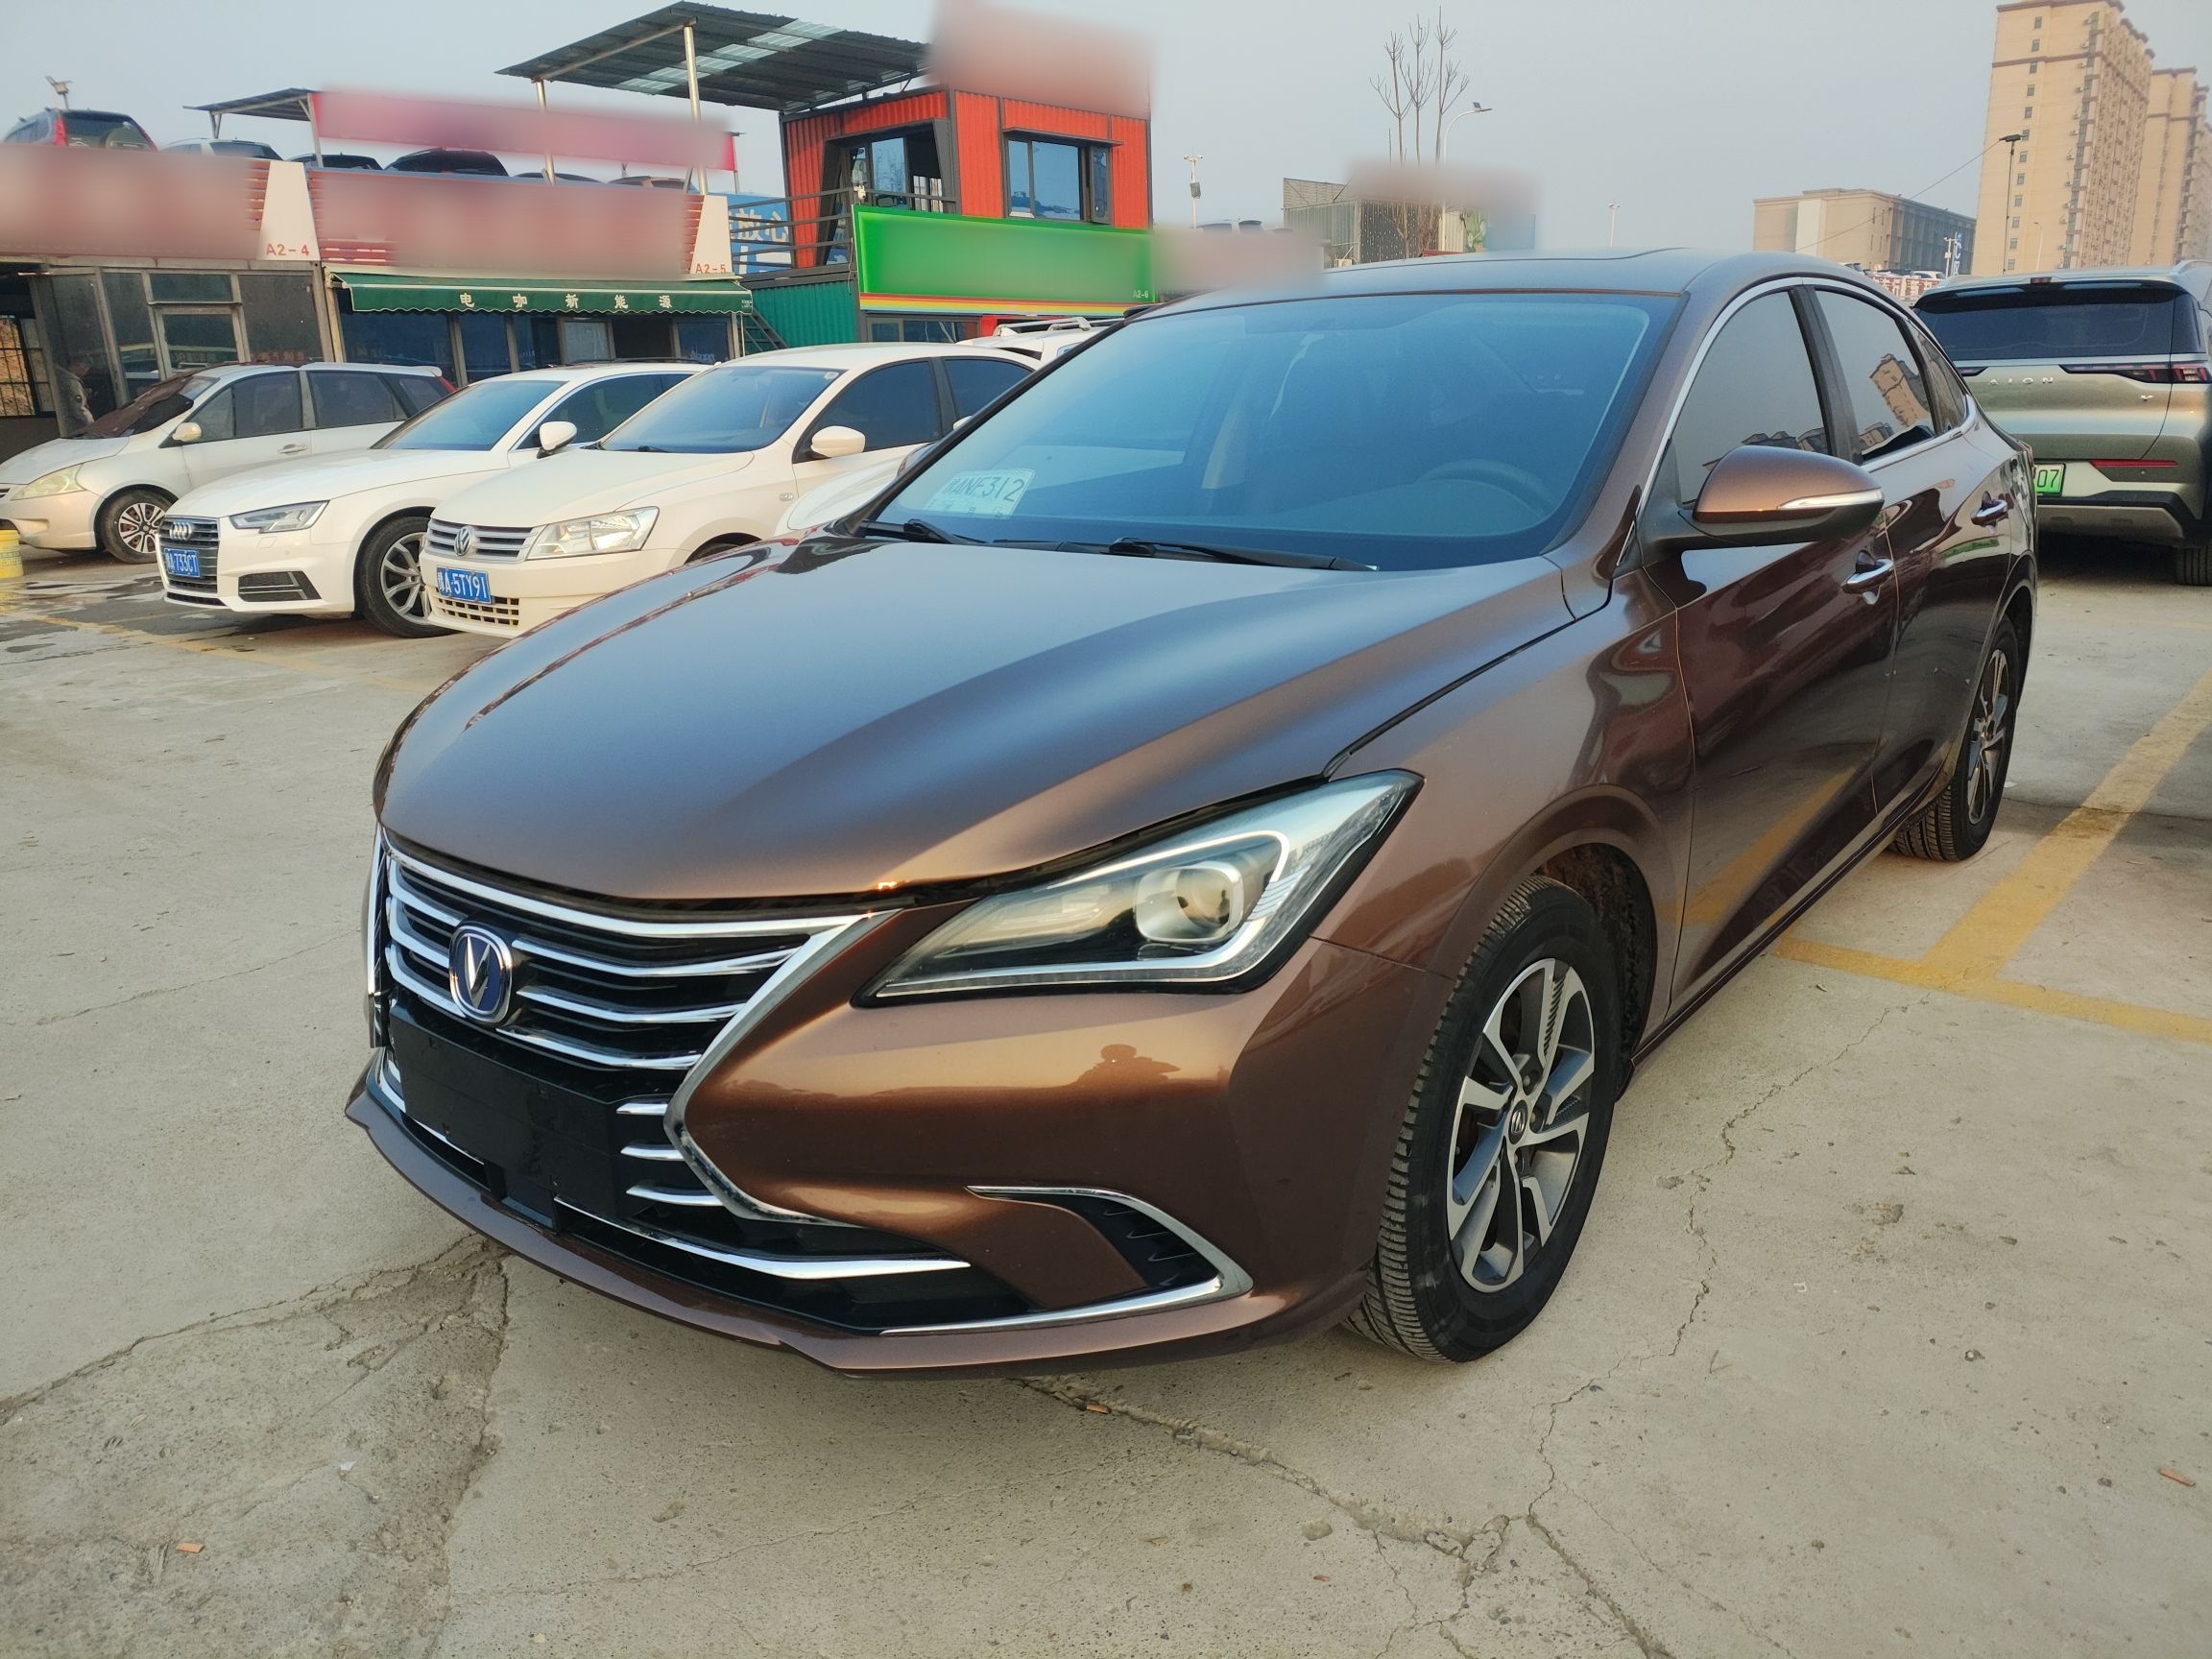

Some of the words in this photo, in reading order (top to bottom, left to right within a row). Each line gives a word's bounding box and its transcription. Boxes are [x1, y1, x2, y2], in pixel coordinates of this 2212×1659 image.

[729, 207, 789, 243] 放心
[266, 243, 310, 257] A2-4
[696, 263, 727, 275] A2-5
[1133, 289, 1149, 299] A2-6
[459, 292, 673, 310] 电咖新能源
[1988, 376, 2055, 385] AION
